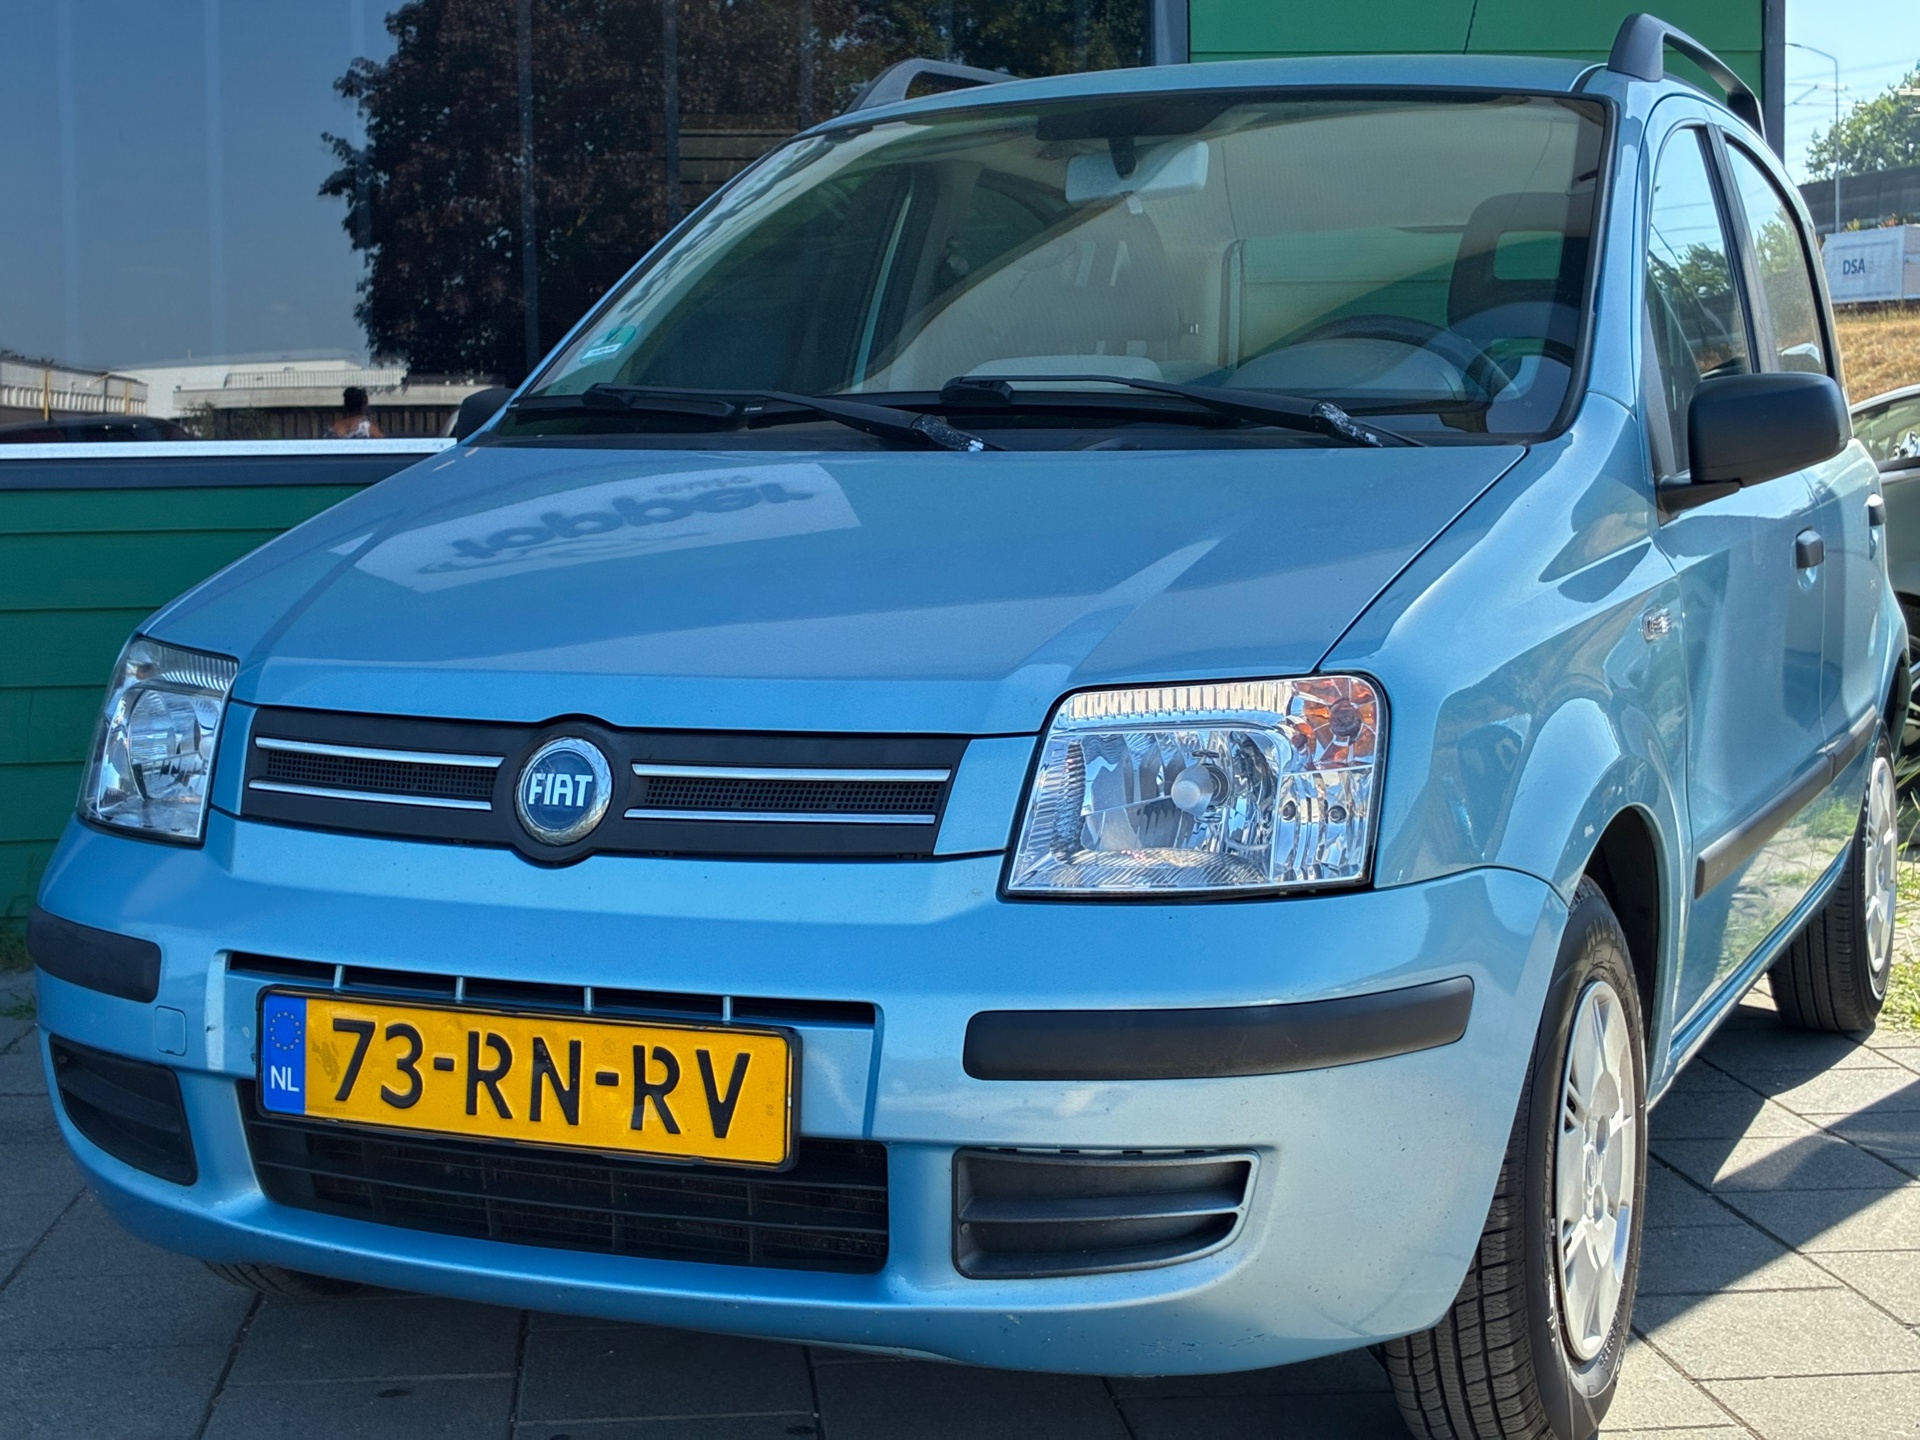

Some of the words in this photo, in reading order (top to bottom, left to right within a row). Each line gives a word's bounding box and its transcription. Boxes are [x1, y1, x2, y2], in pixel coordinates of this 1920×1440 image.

[1842, 258, 1866, 276] DSA
[528, 772, 593, 807] FIAT
[270, 1065, 299, 1093] NL
[332, 1018, 752, 1139] 73-RN-RV
